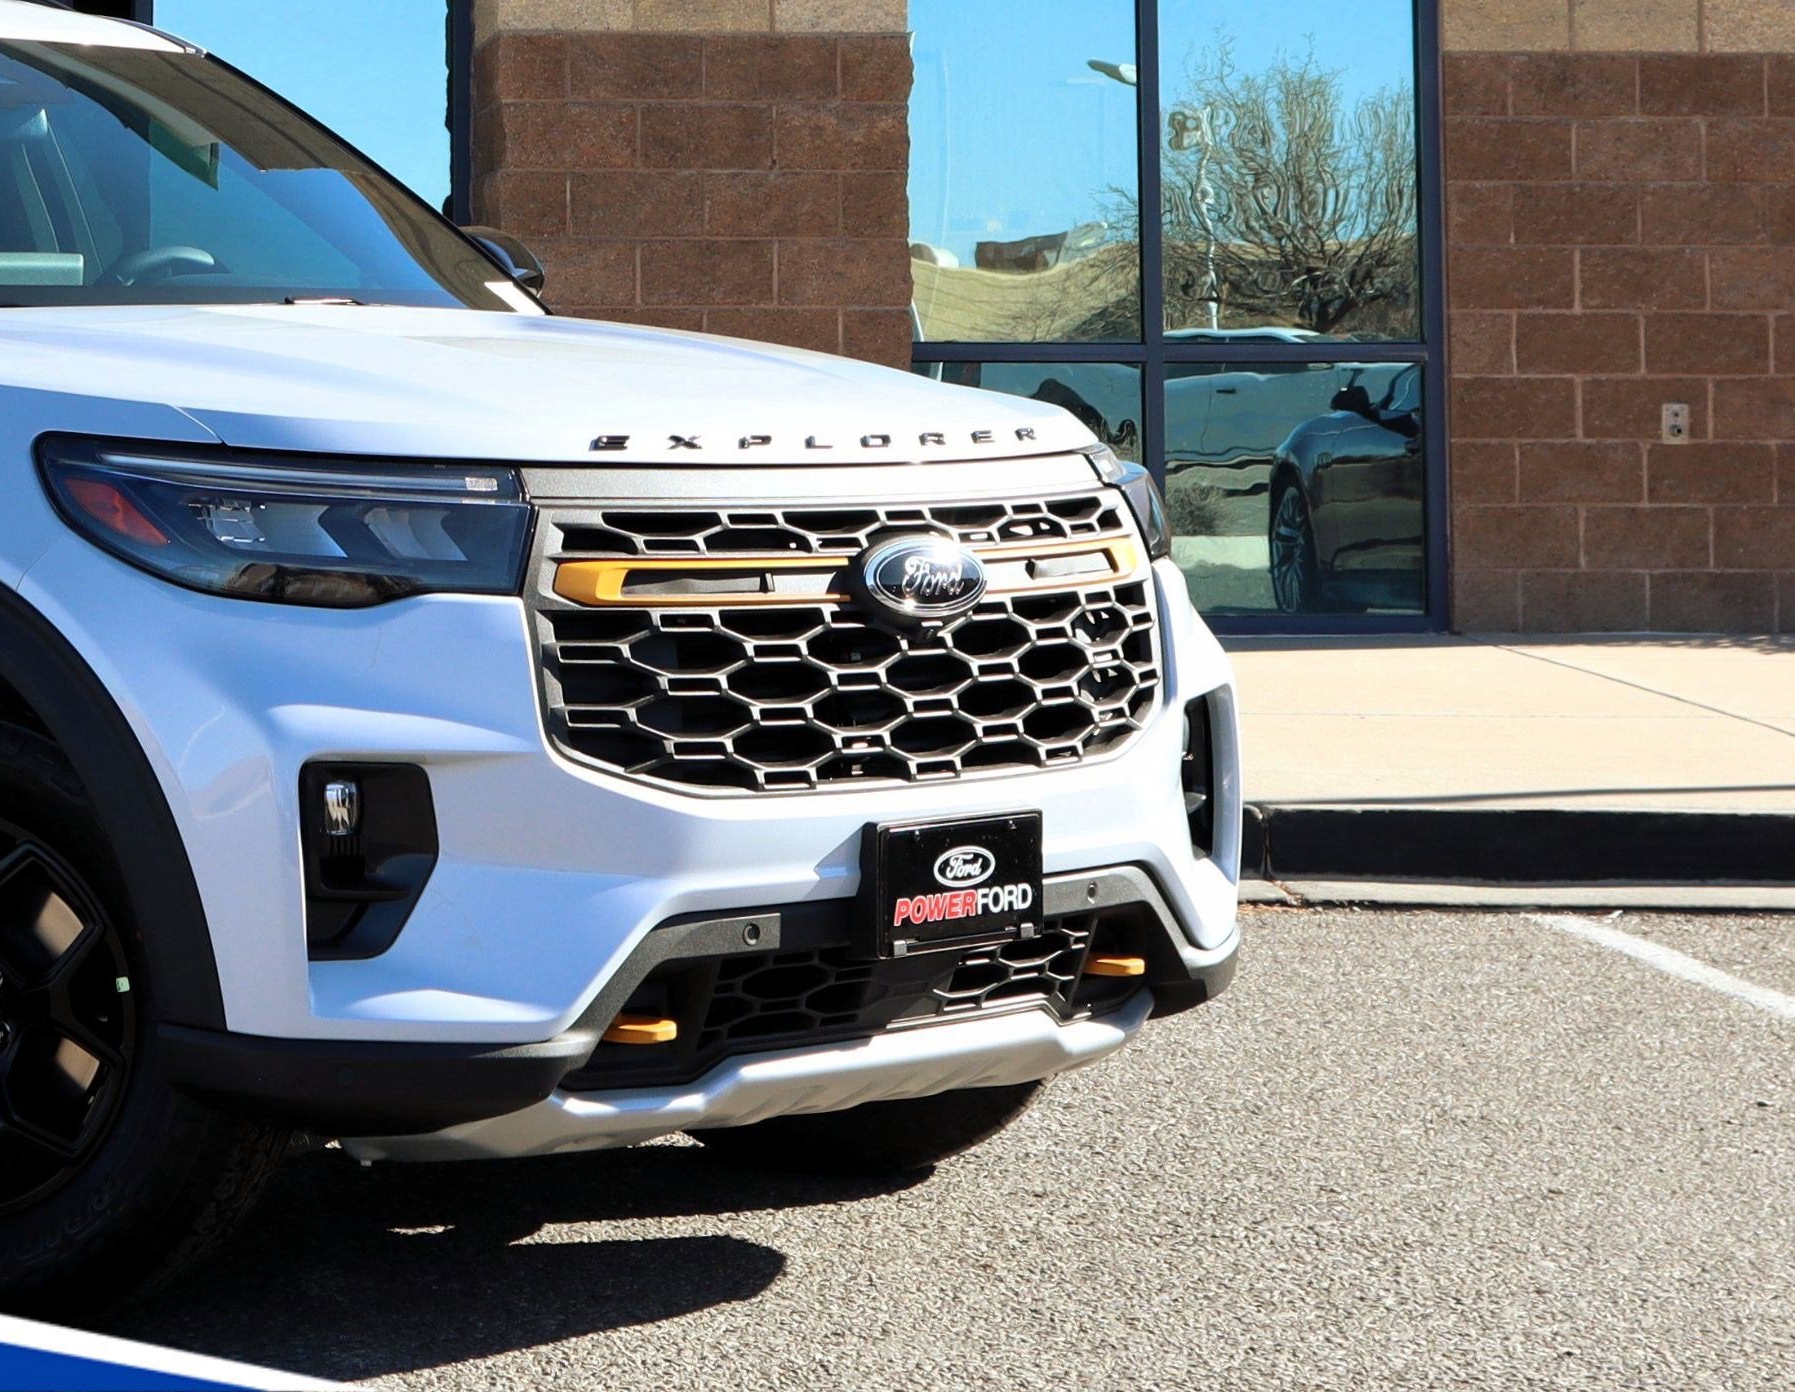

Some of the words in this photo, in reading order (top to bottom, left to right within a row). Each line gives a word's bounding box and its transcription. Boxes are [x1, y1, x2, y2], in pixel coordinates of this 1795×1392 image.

[589, 426, 1037, 451] EXPLORER
[901, 555, 965, 597] Ford
[945, 853, 983, 879] Ford
